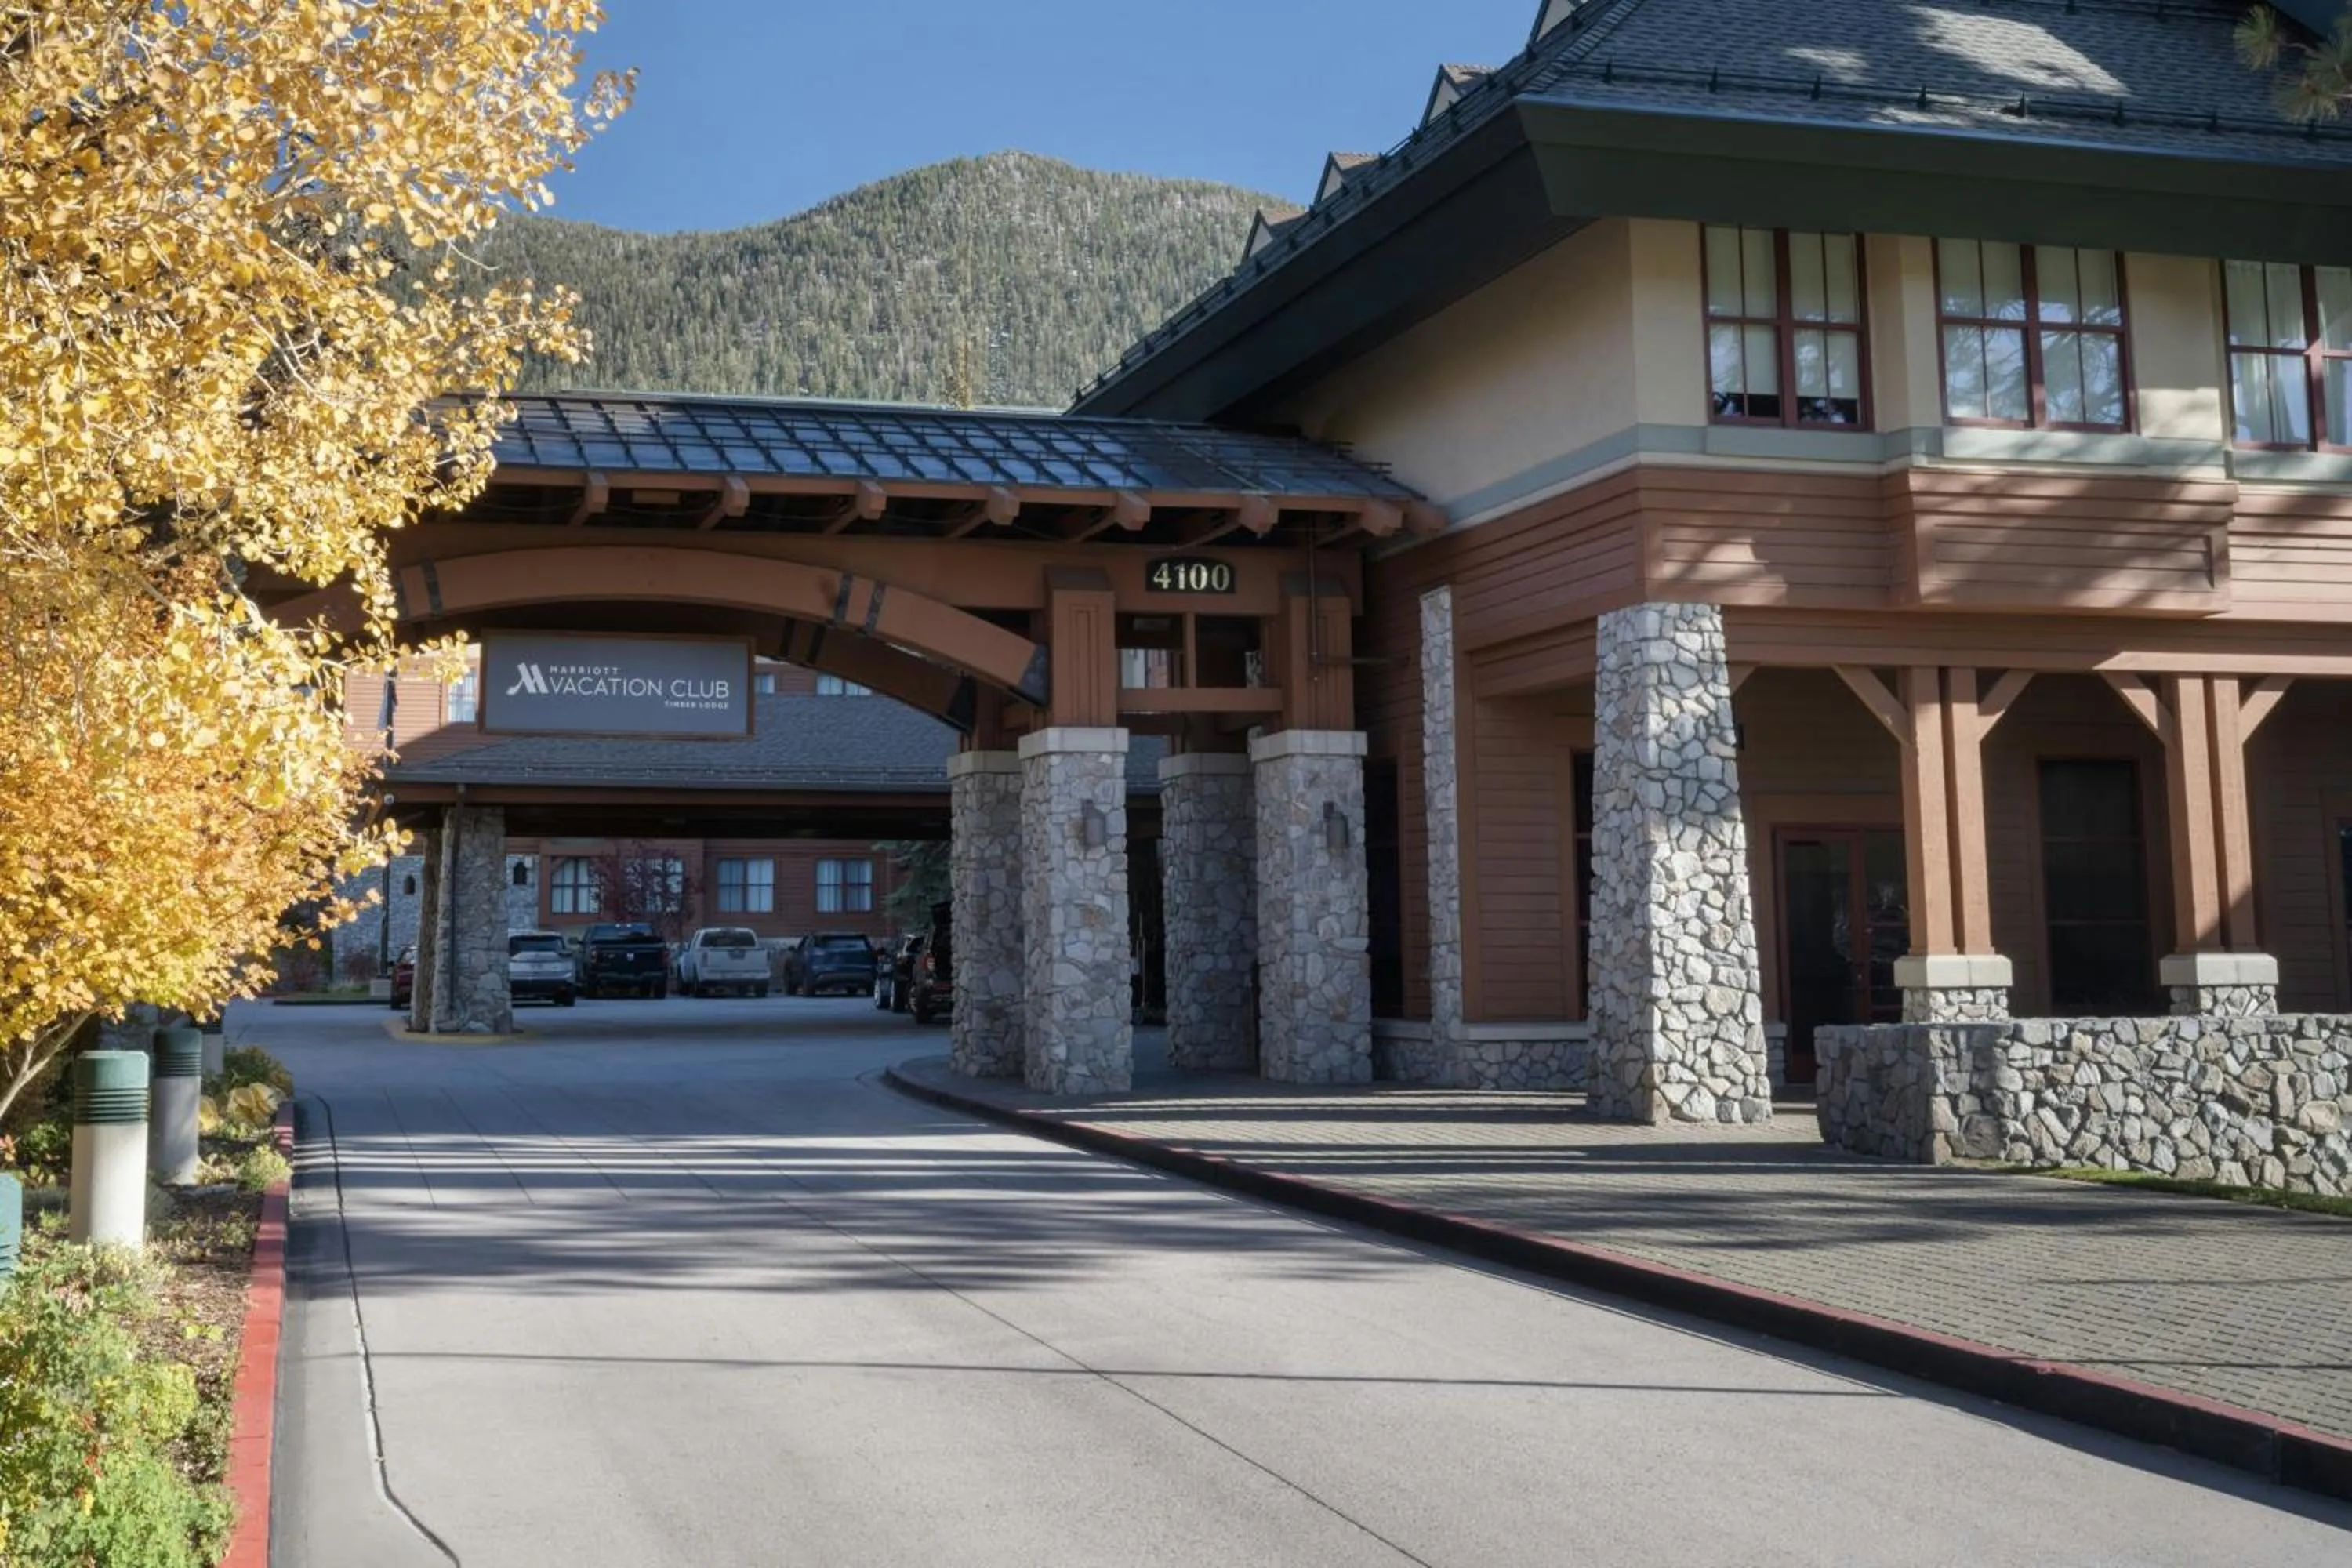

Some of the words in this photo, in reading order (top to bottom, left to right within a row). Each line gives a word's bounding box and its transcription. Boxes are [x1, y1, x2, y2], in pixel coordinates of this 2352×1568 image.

[1153, 562, 1230, 590] 4100
[550, 665, 619, 675] MARRIOTT
[550, 677, 662, 696] VACATION
[670, 679, 728, 699] CLUB
